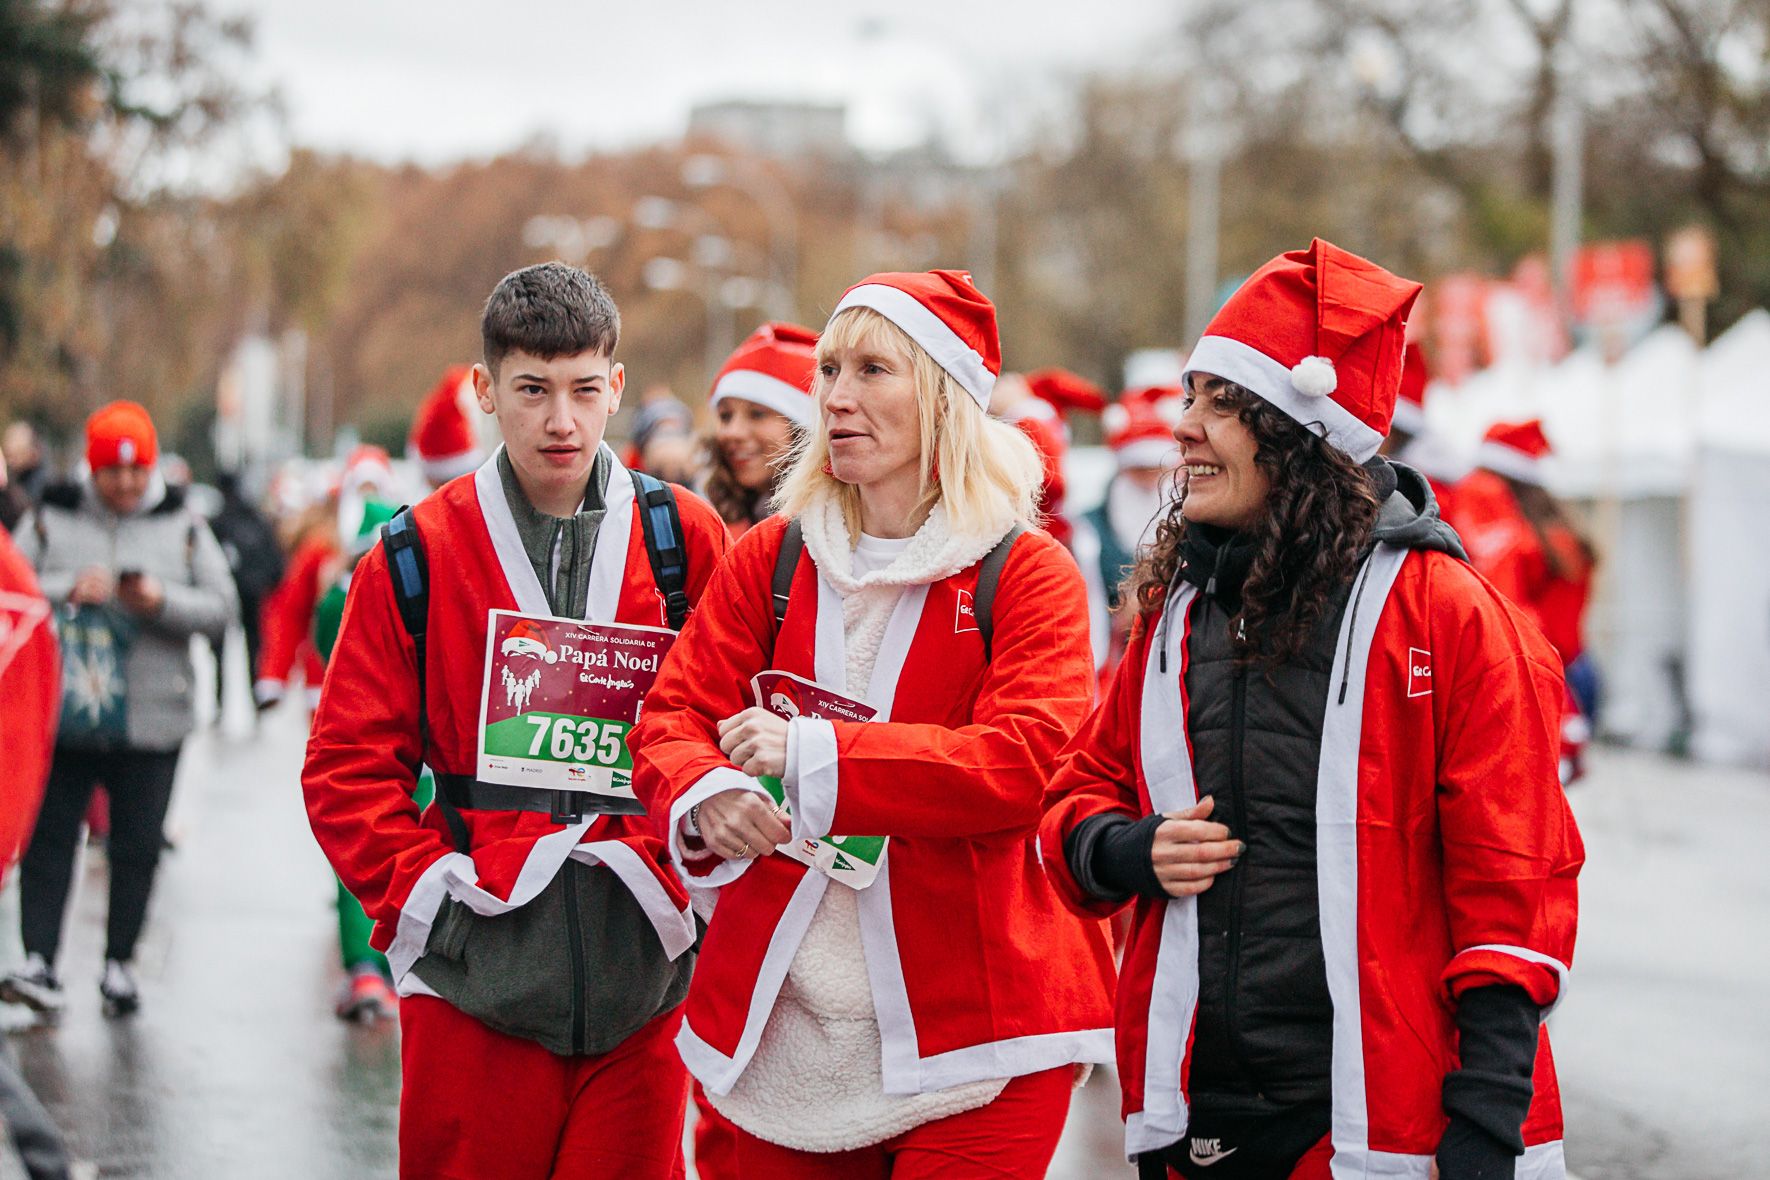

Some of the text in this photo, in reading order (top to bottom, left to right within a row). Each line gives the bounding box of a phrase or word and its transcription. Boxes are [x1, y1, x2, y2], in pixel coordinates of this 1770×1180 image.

[578, 633, 608, 642] CARRERA
[610, 637, 645, 646] SOLIDARIA
[558, 644, 658, 672] Papá Noel
[818, 700, 830, 708] XIV
[829, 704, 857, 719] CARRERA
[527, 715, 623, 765] 7635
[1191, 1137, 1221, 1156] NIKE
